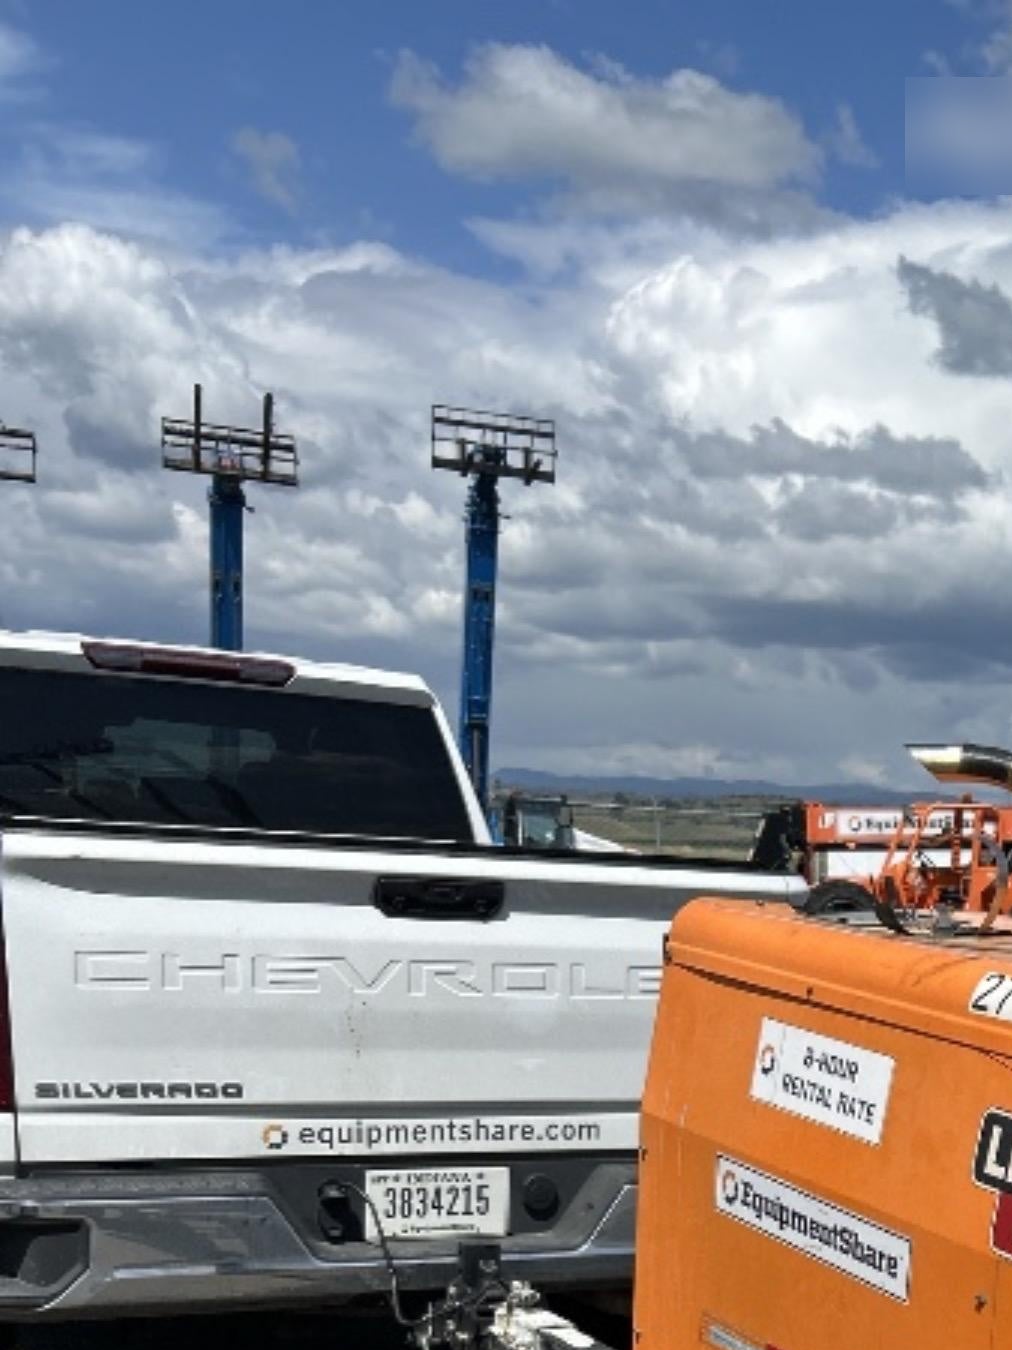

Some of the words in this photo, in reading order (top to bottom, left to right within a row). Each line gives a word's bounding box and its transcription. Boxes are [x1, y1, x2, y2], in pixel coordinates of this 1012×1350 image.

[74, 951, 664, 1001] CHEVROLE
[35, 1083, 244, 1099] SILVERADO
[782, 1074, 833, 1110] RENTAL
[836, 1092, 877, 1126] RATE
[298, 1119, 601, 1150] equipmentshare.com
[383, 1185, 490, 1218] 3834215
[740, 1179, 899, 1278] EquipmentShare
